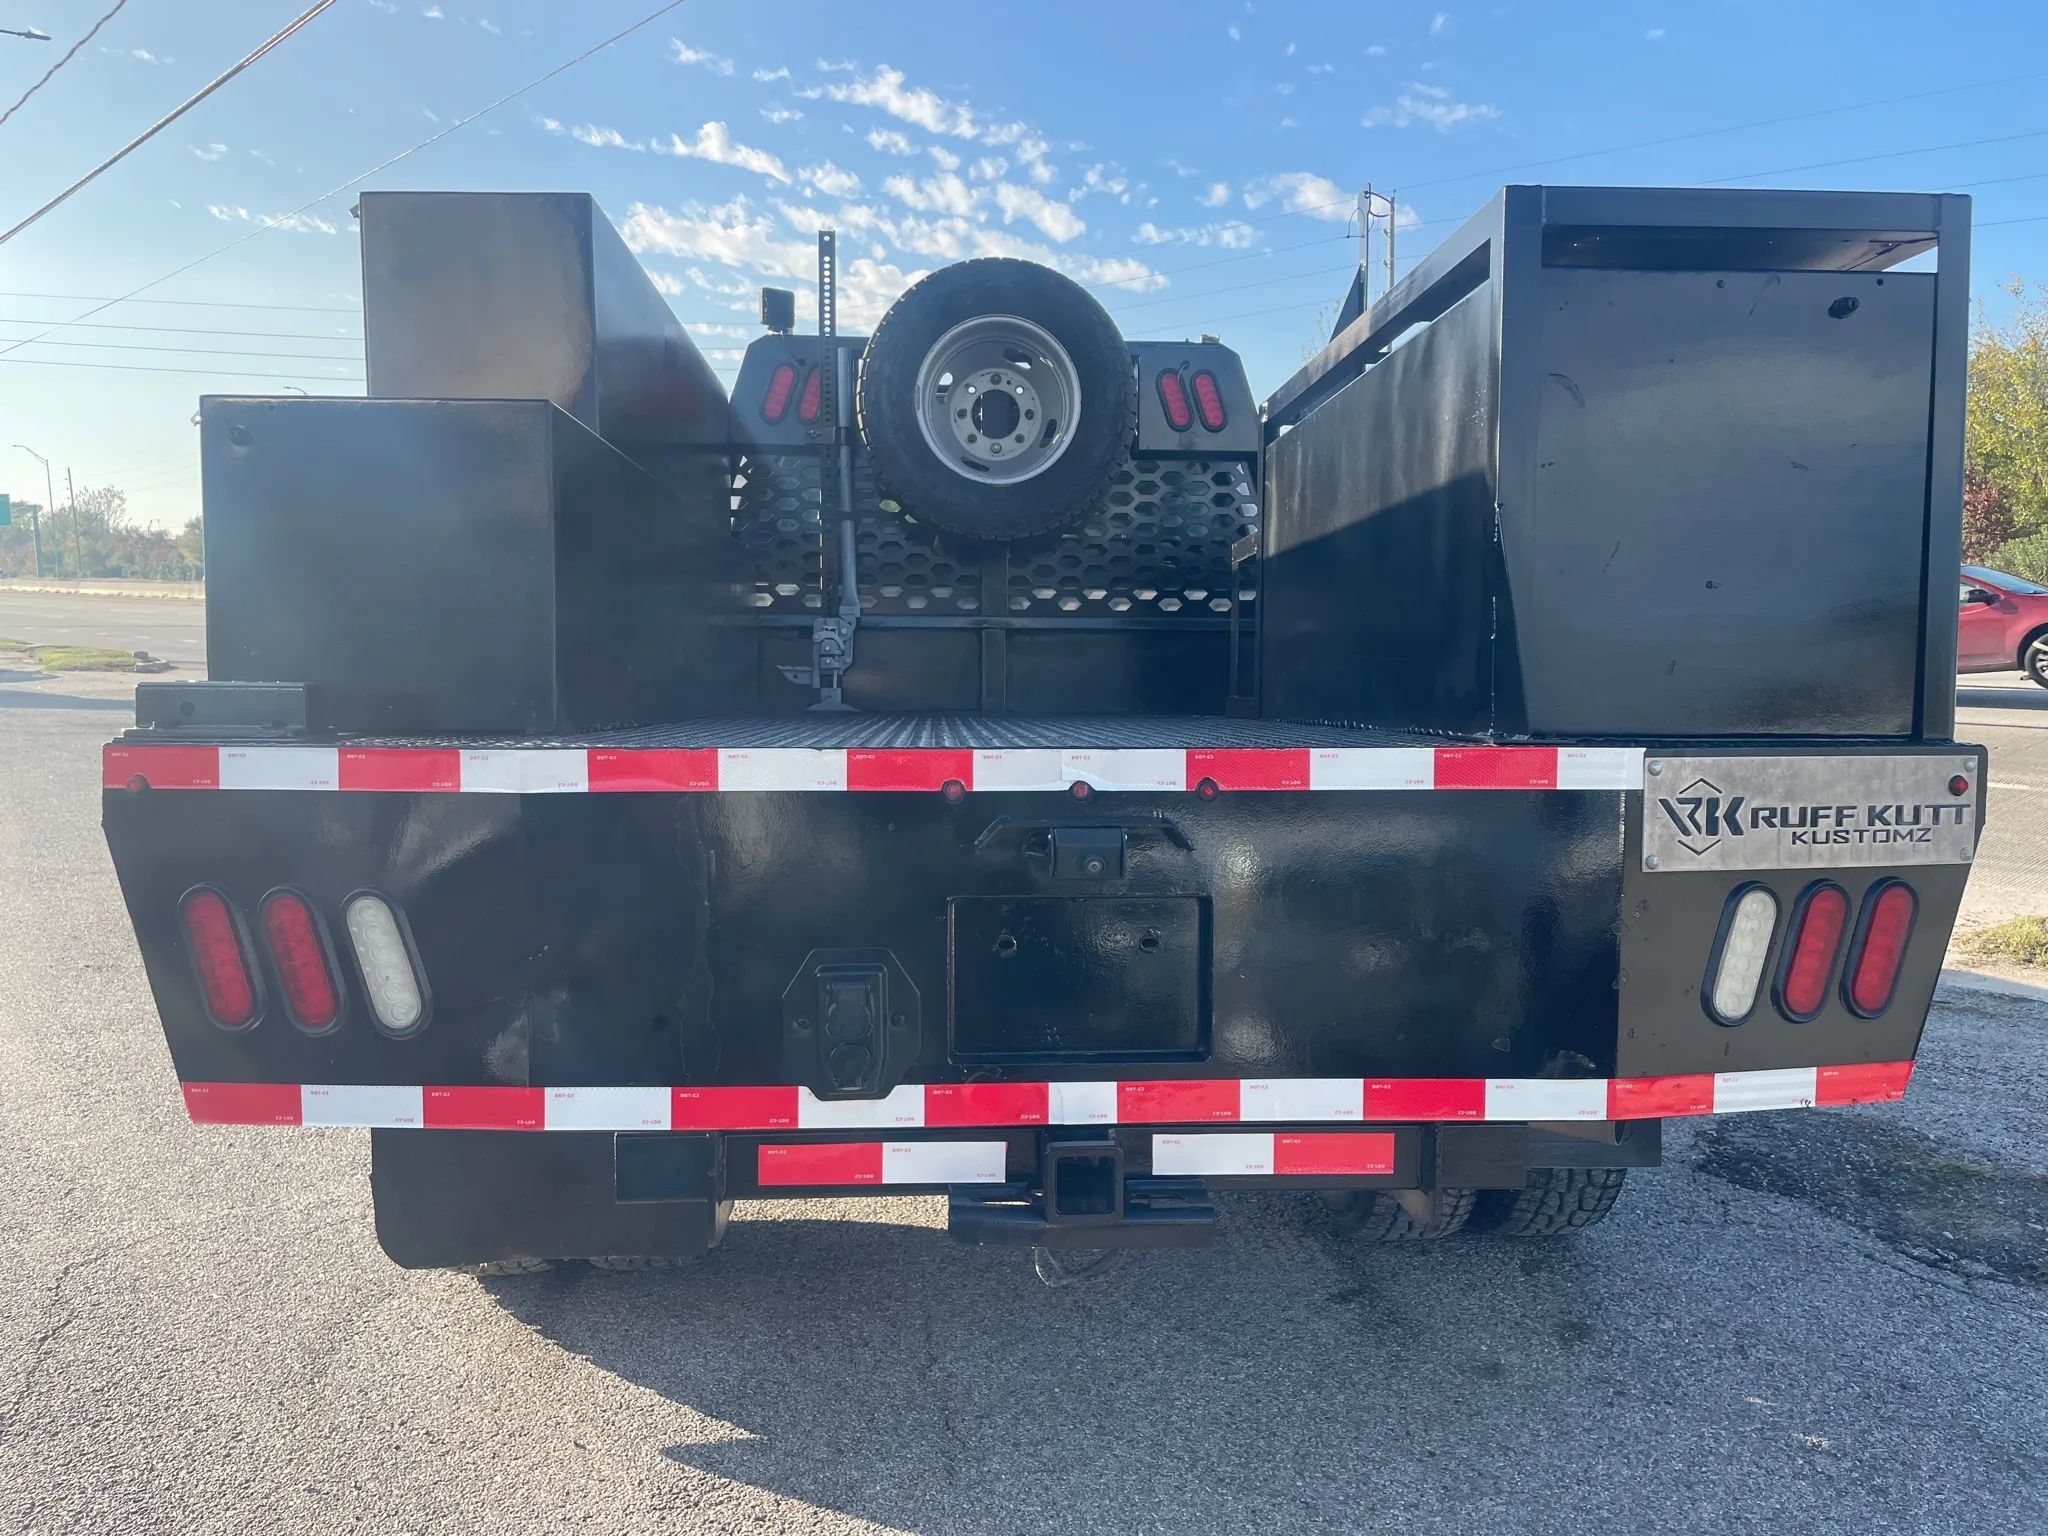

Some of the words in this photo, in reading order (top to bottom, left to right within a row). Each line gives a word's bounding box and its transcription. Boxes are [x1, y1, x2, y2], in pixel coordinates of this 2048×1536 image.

[1750, 806, 1858, 829] RUFF
[1867, 803, 1971, 827] KUTT
[1791, 828, 1932, 846] KUSTOMZ
